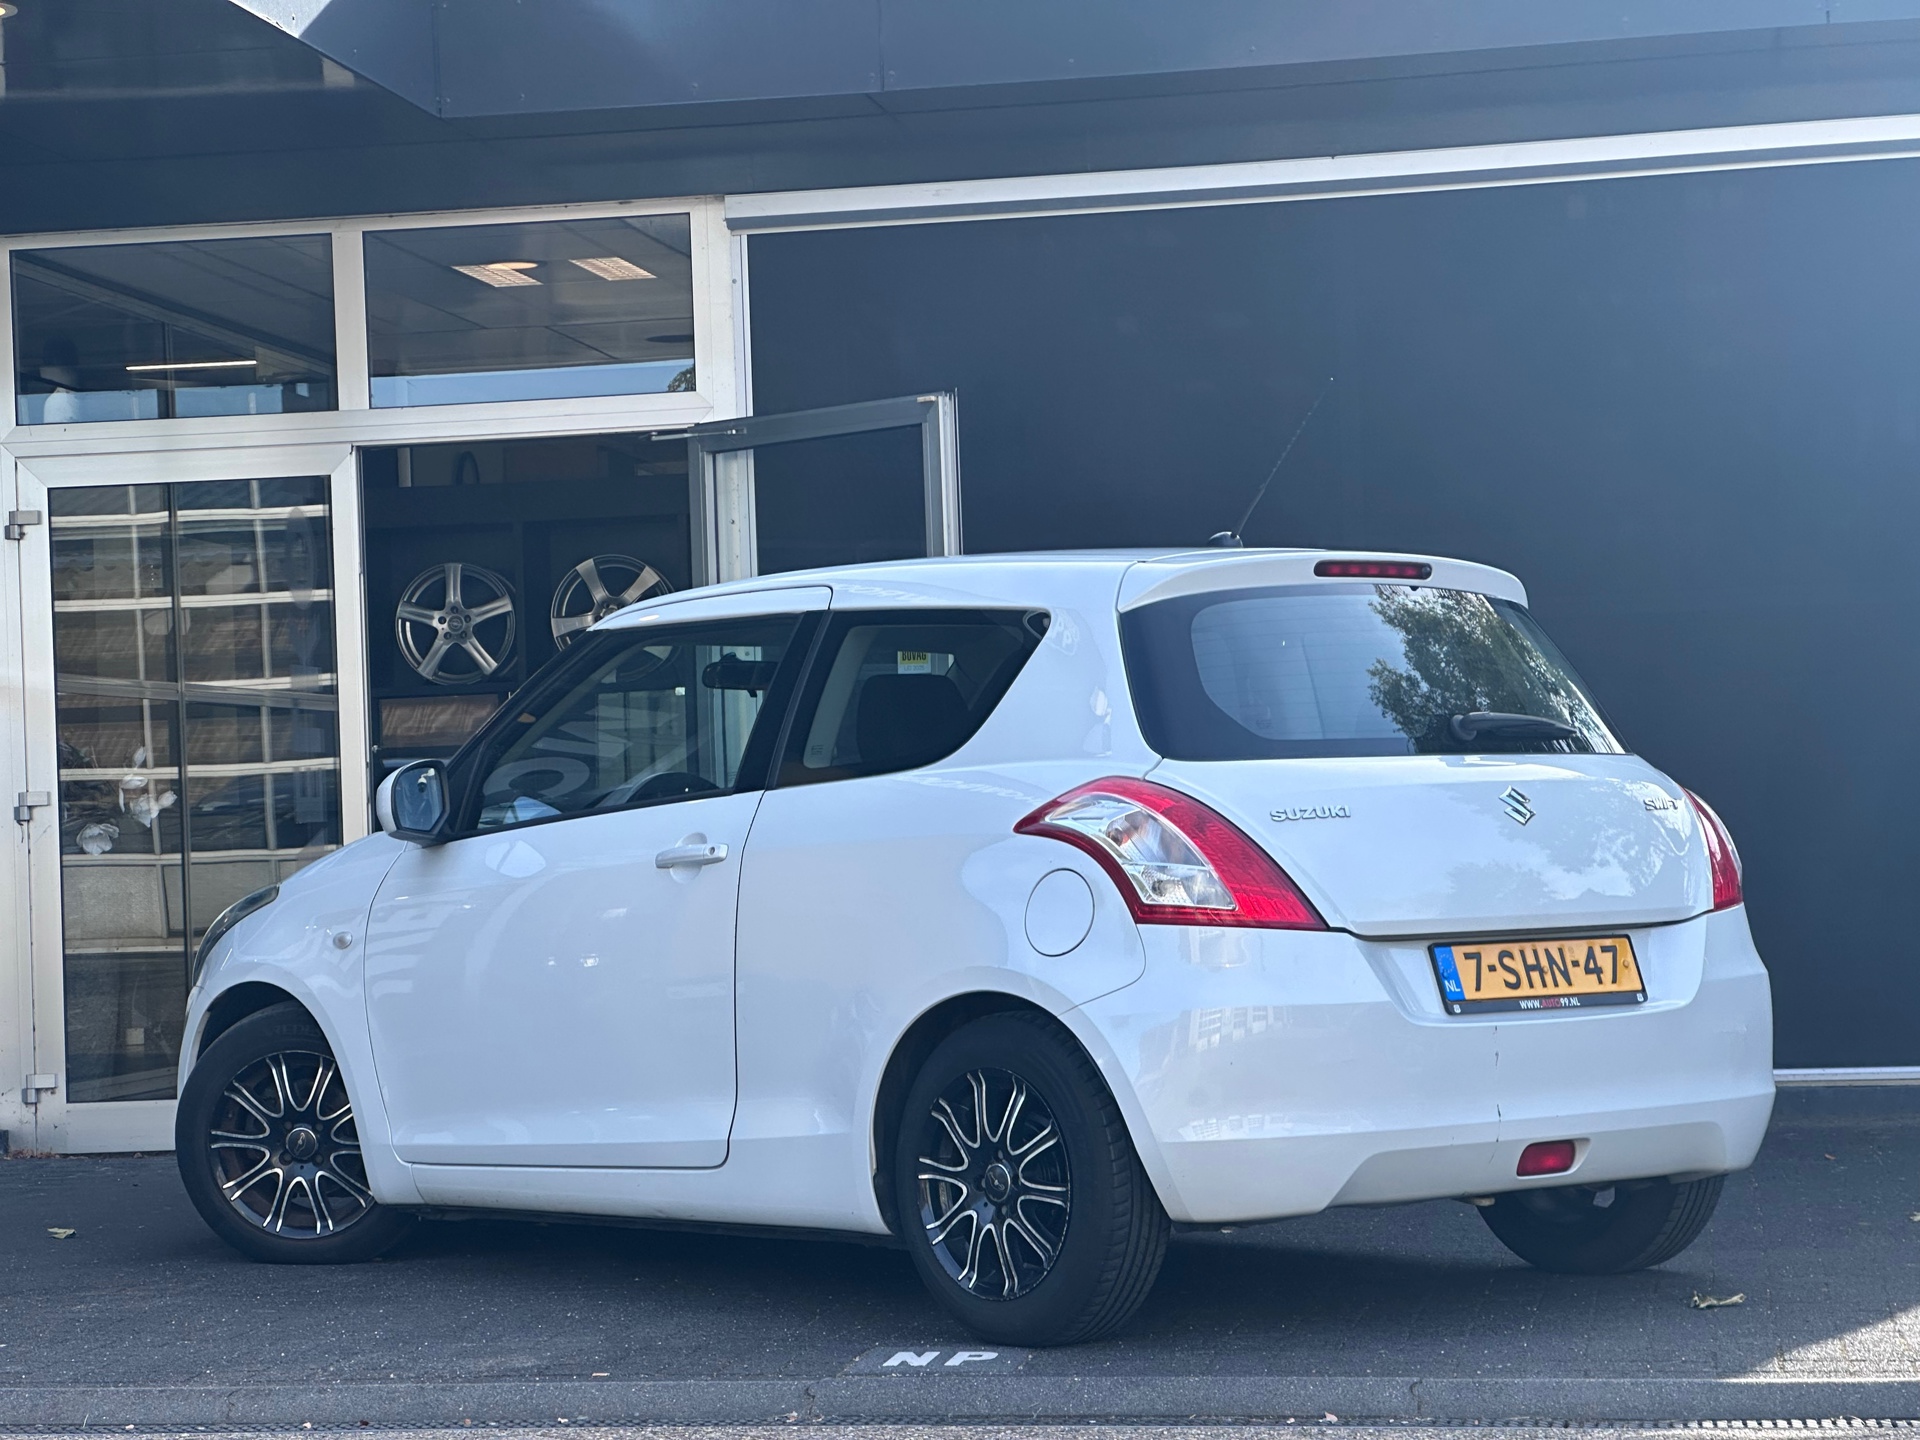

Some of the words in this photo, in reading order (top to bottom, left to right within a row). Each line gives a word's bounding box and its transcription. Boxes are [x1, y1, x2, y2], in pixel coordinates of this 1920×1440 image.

[1269, 804, 1352, 822] SUZUKI
[1462, 944, 1619, 992] 7-SHN-47
[1444, 980, 1461, 993] NL
[1519, 997, 1581, 1010] WWW.AUTO99.NL
